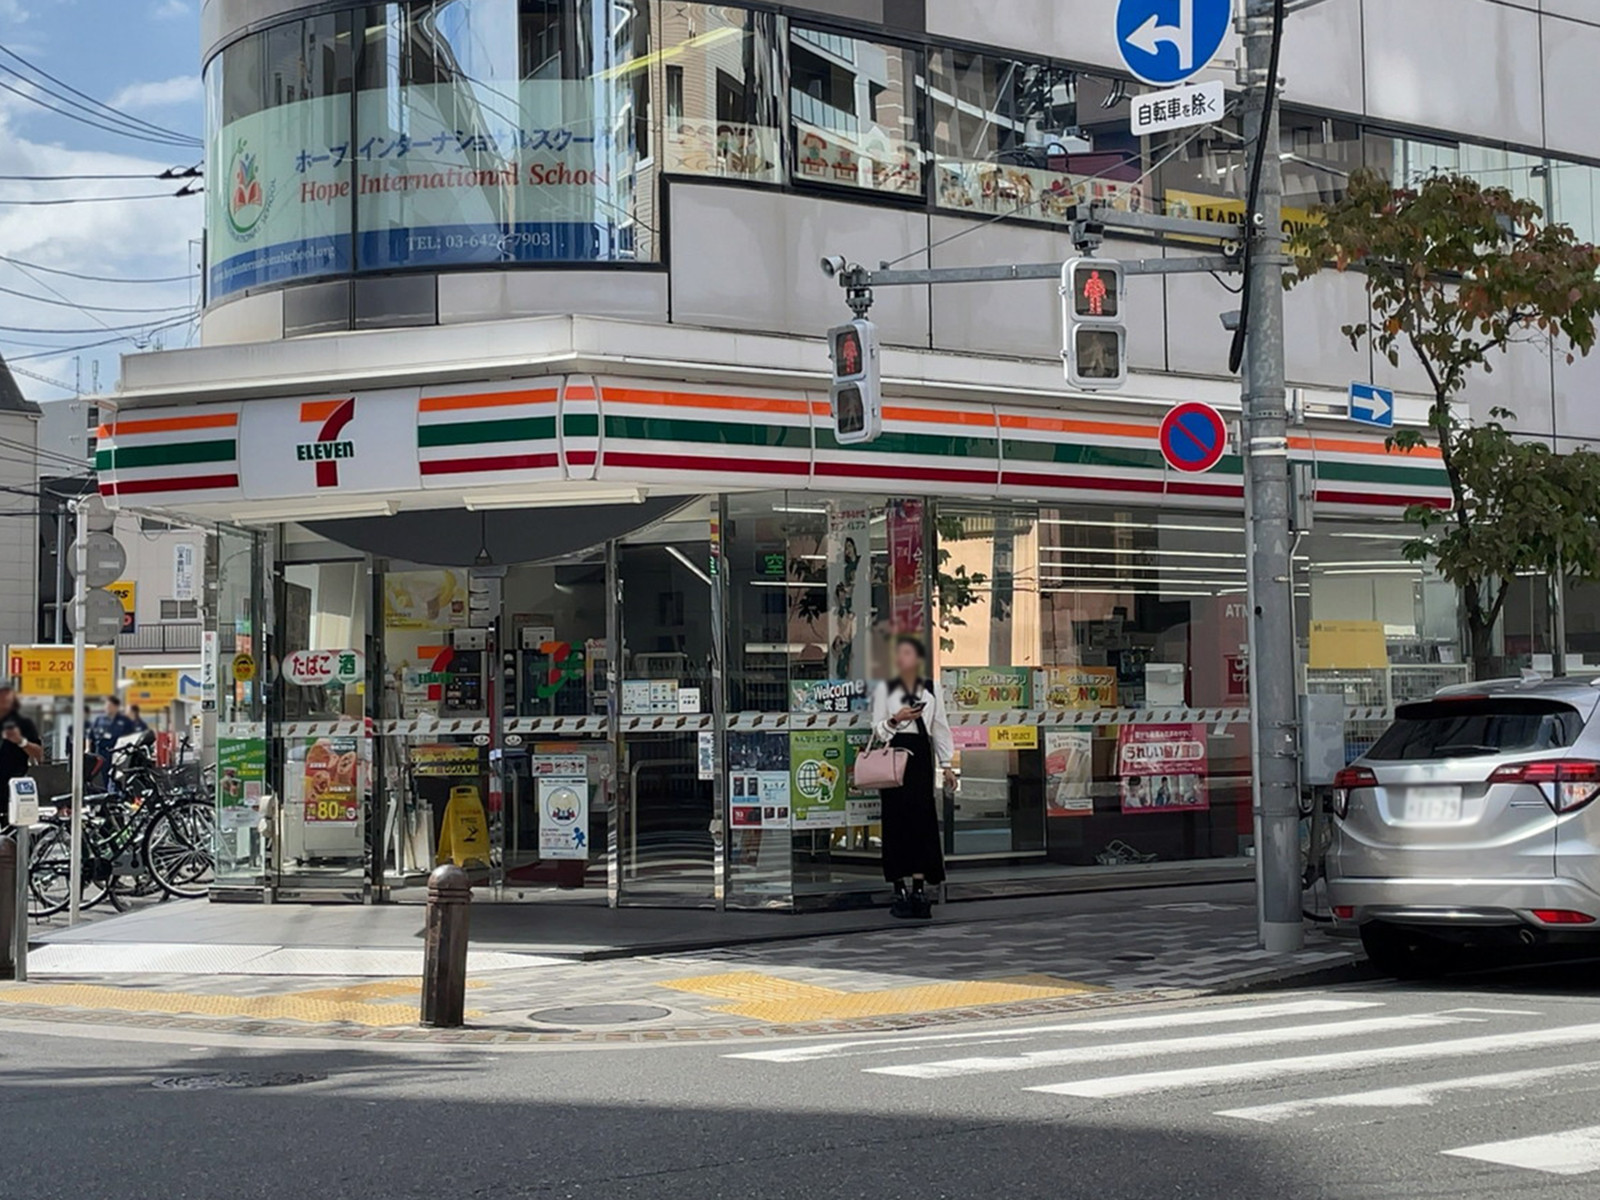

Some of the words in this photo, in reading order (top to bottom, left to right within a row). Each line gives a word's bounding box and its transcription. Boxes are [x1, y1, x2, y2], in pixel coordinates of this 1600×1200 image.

[1137, 94, 1216, 126] 自転車を除く
[301, 179, 350, 206] Hope
[359, 162, 519, 195] International
[529, 161, 610, 187] School
[406, 235, 442, 252] TEL:
[292, 654, 332, 676] たばこ
[338, 654, 356, 676] 酒
[813, 679, 865, 701] Welcome
[317, 801, 339, 820] 80
